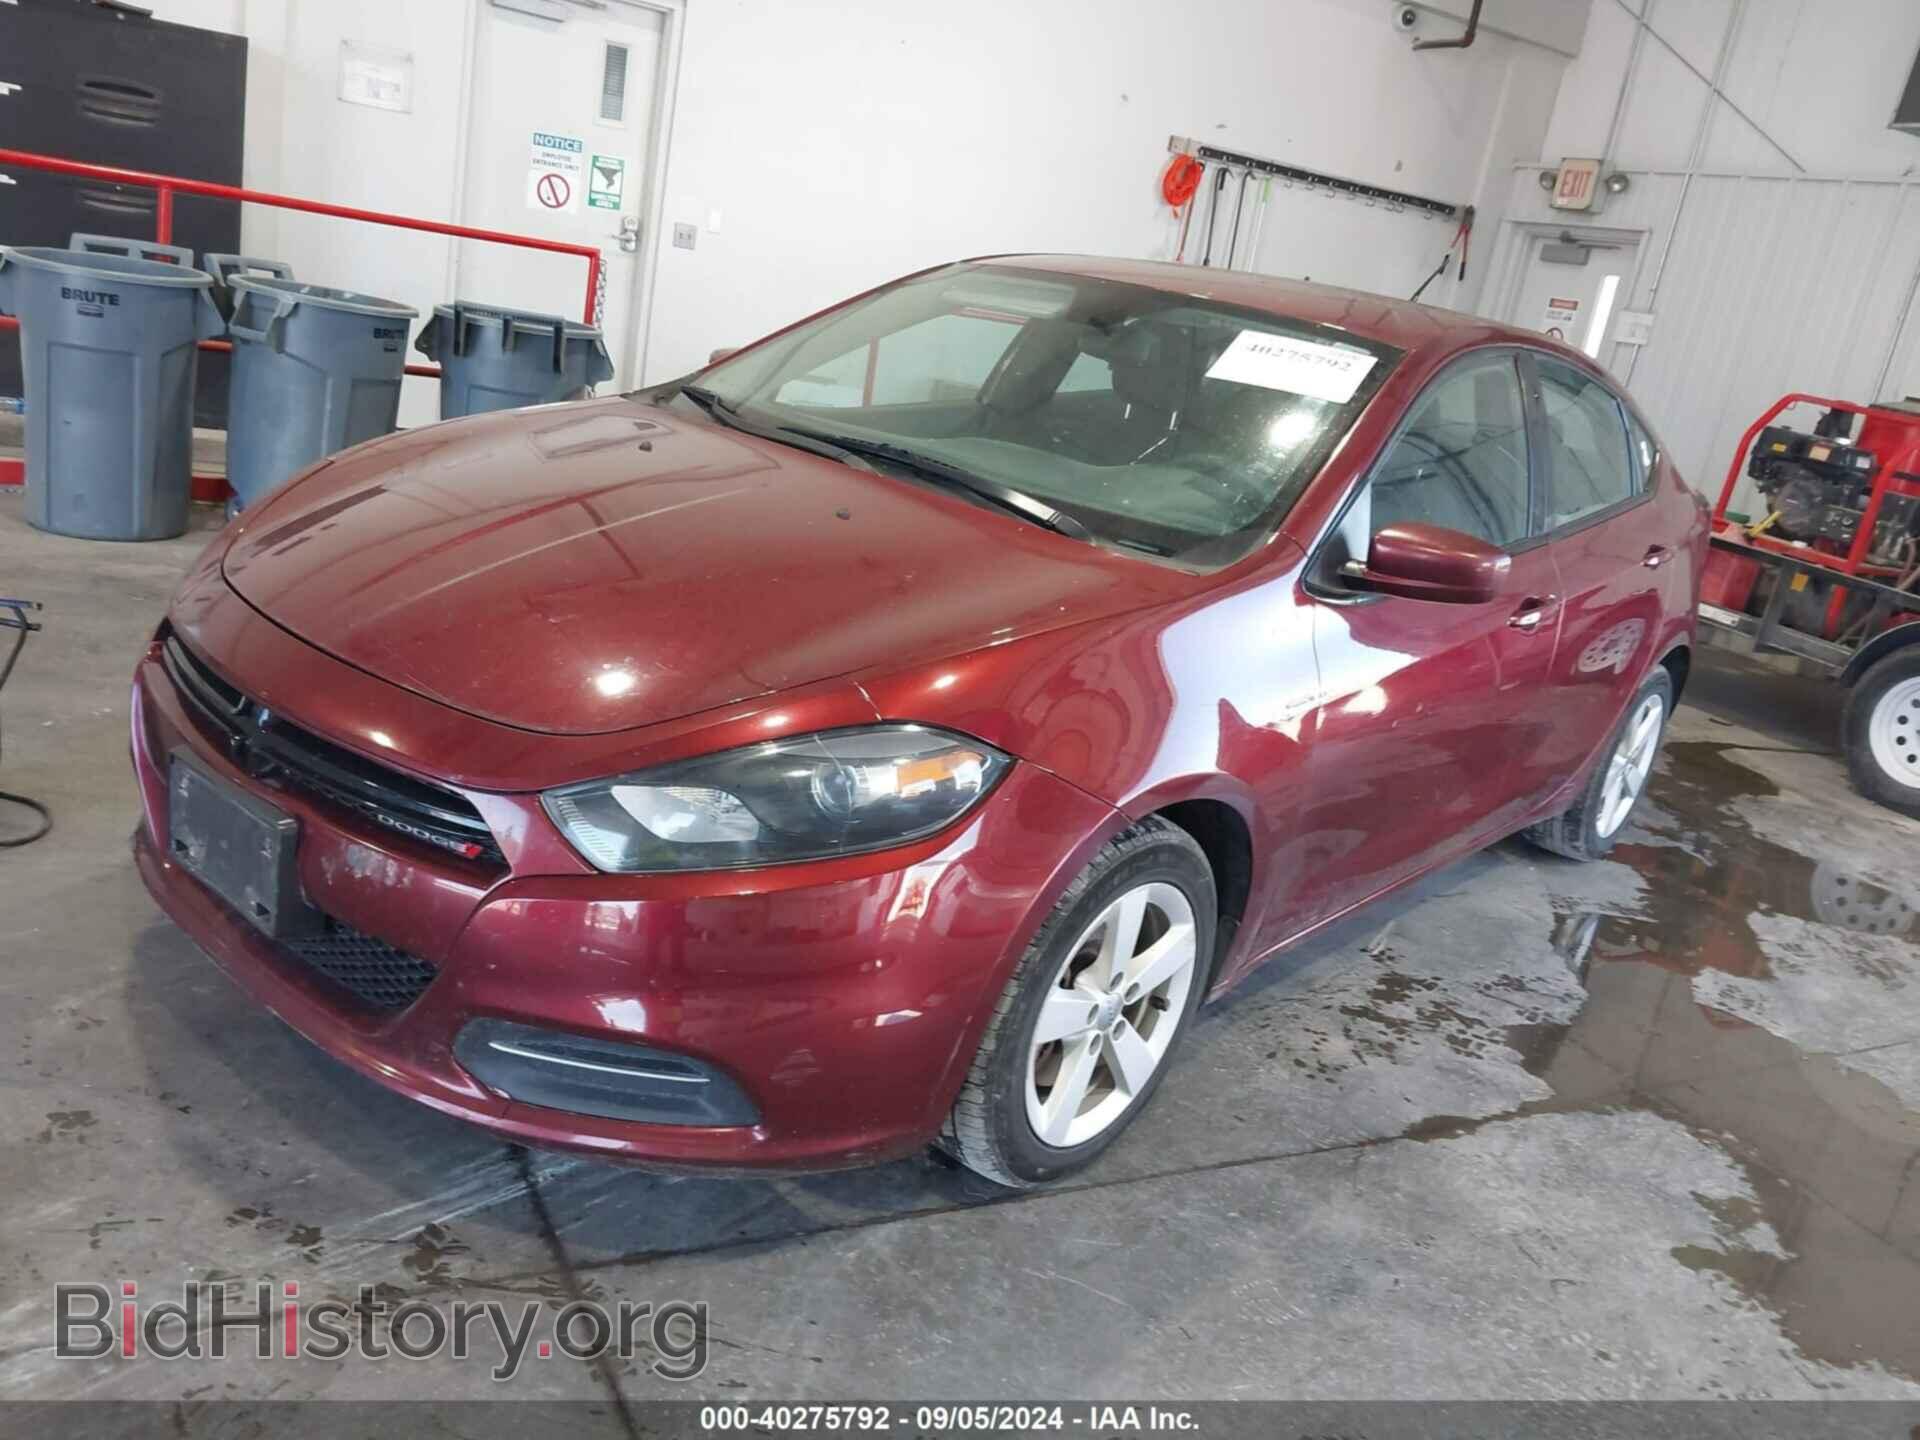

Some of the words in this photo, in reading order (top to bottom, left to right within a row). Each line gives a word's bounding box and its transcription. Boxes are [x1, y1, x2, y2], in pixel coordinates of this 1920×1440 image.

[535, 134, 581, 152] NOTICE
[1559, 170, 1592, 198] EXIT
[61, 287, 120, 306] BRUTE
